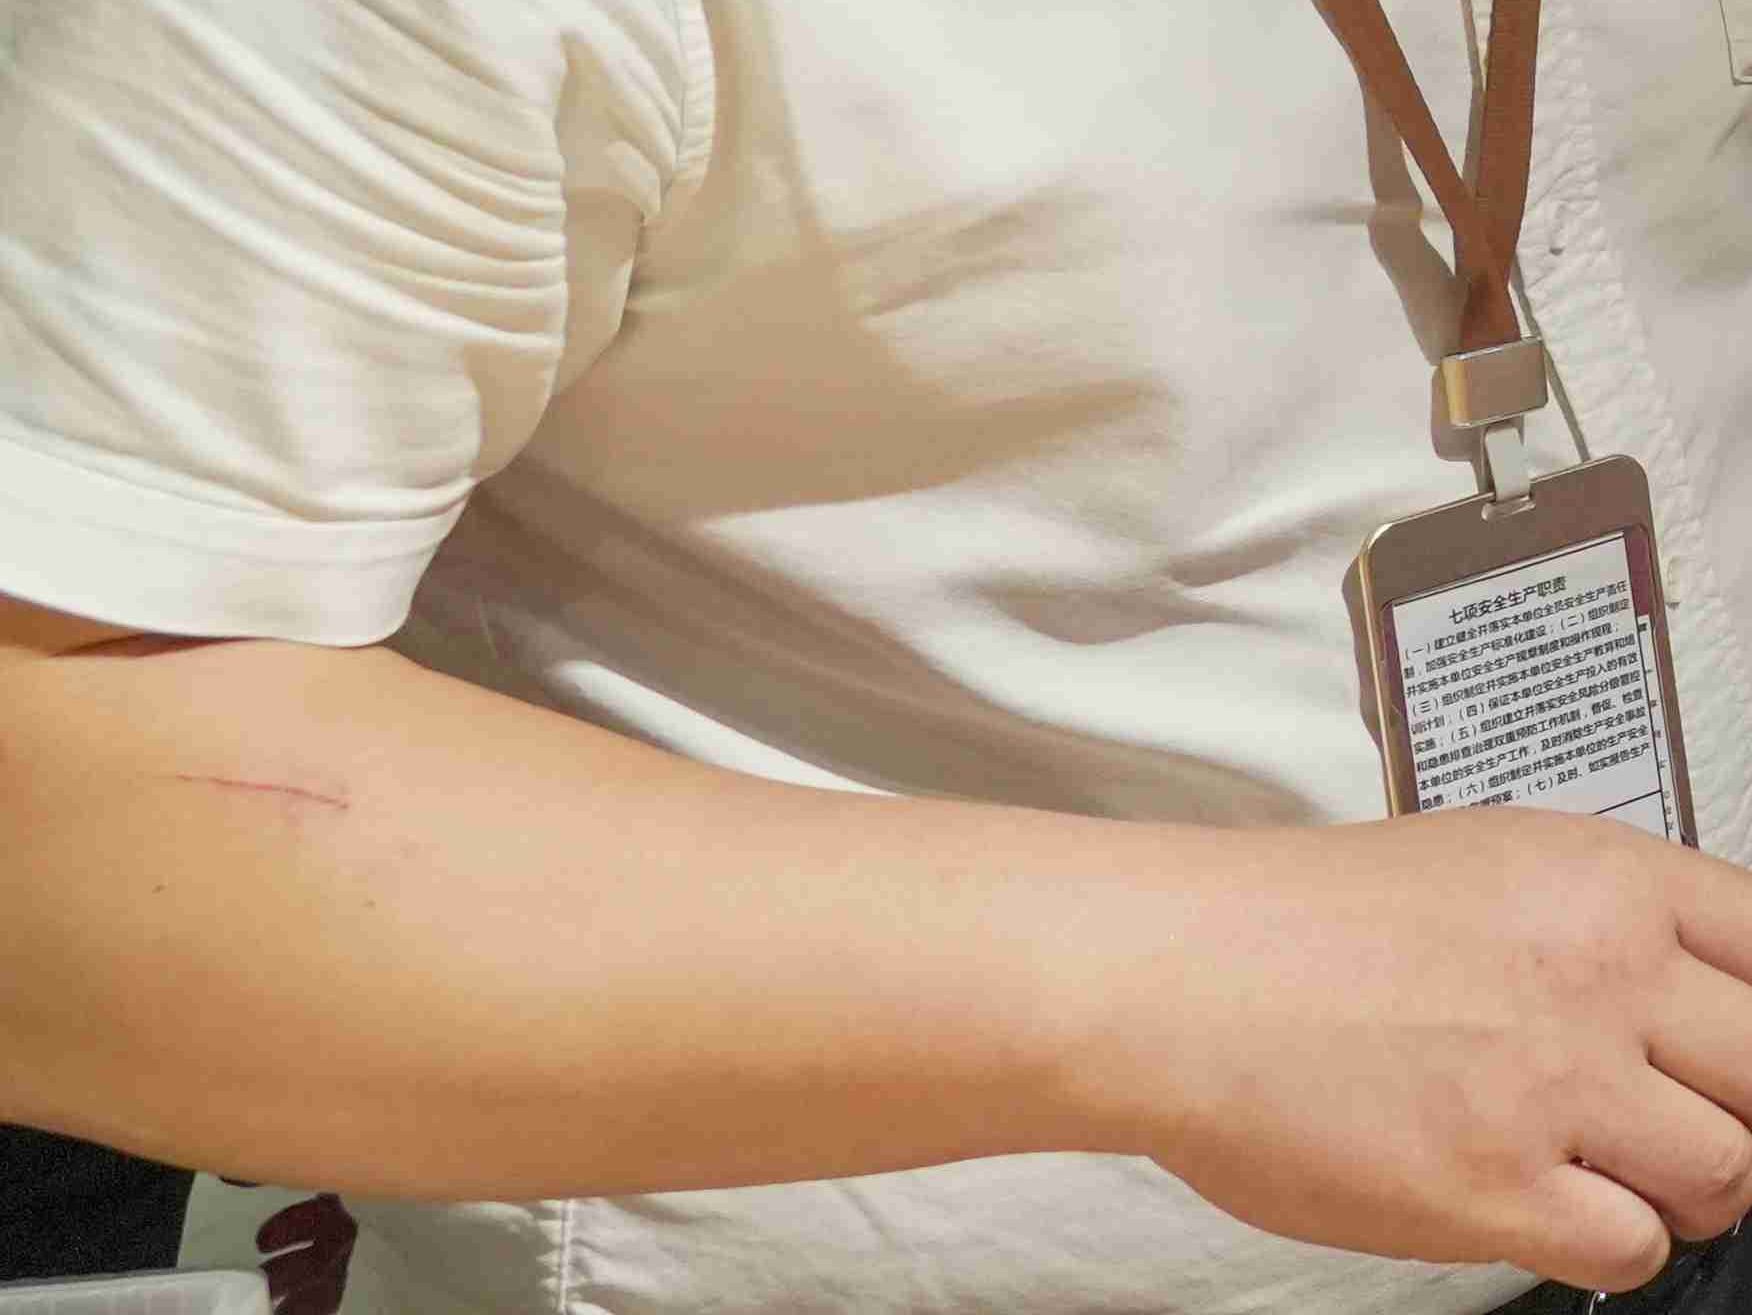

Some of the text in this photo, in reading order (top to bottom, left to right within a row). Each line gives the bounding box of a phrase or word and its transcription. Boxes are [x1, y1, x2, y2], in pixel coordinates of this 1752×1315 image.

[1448, 576, 1567, 625] 七项安全生产职责
